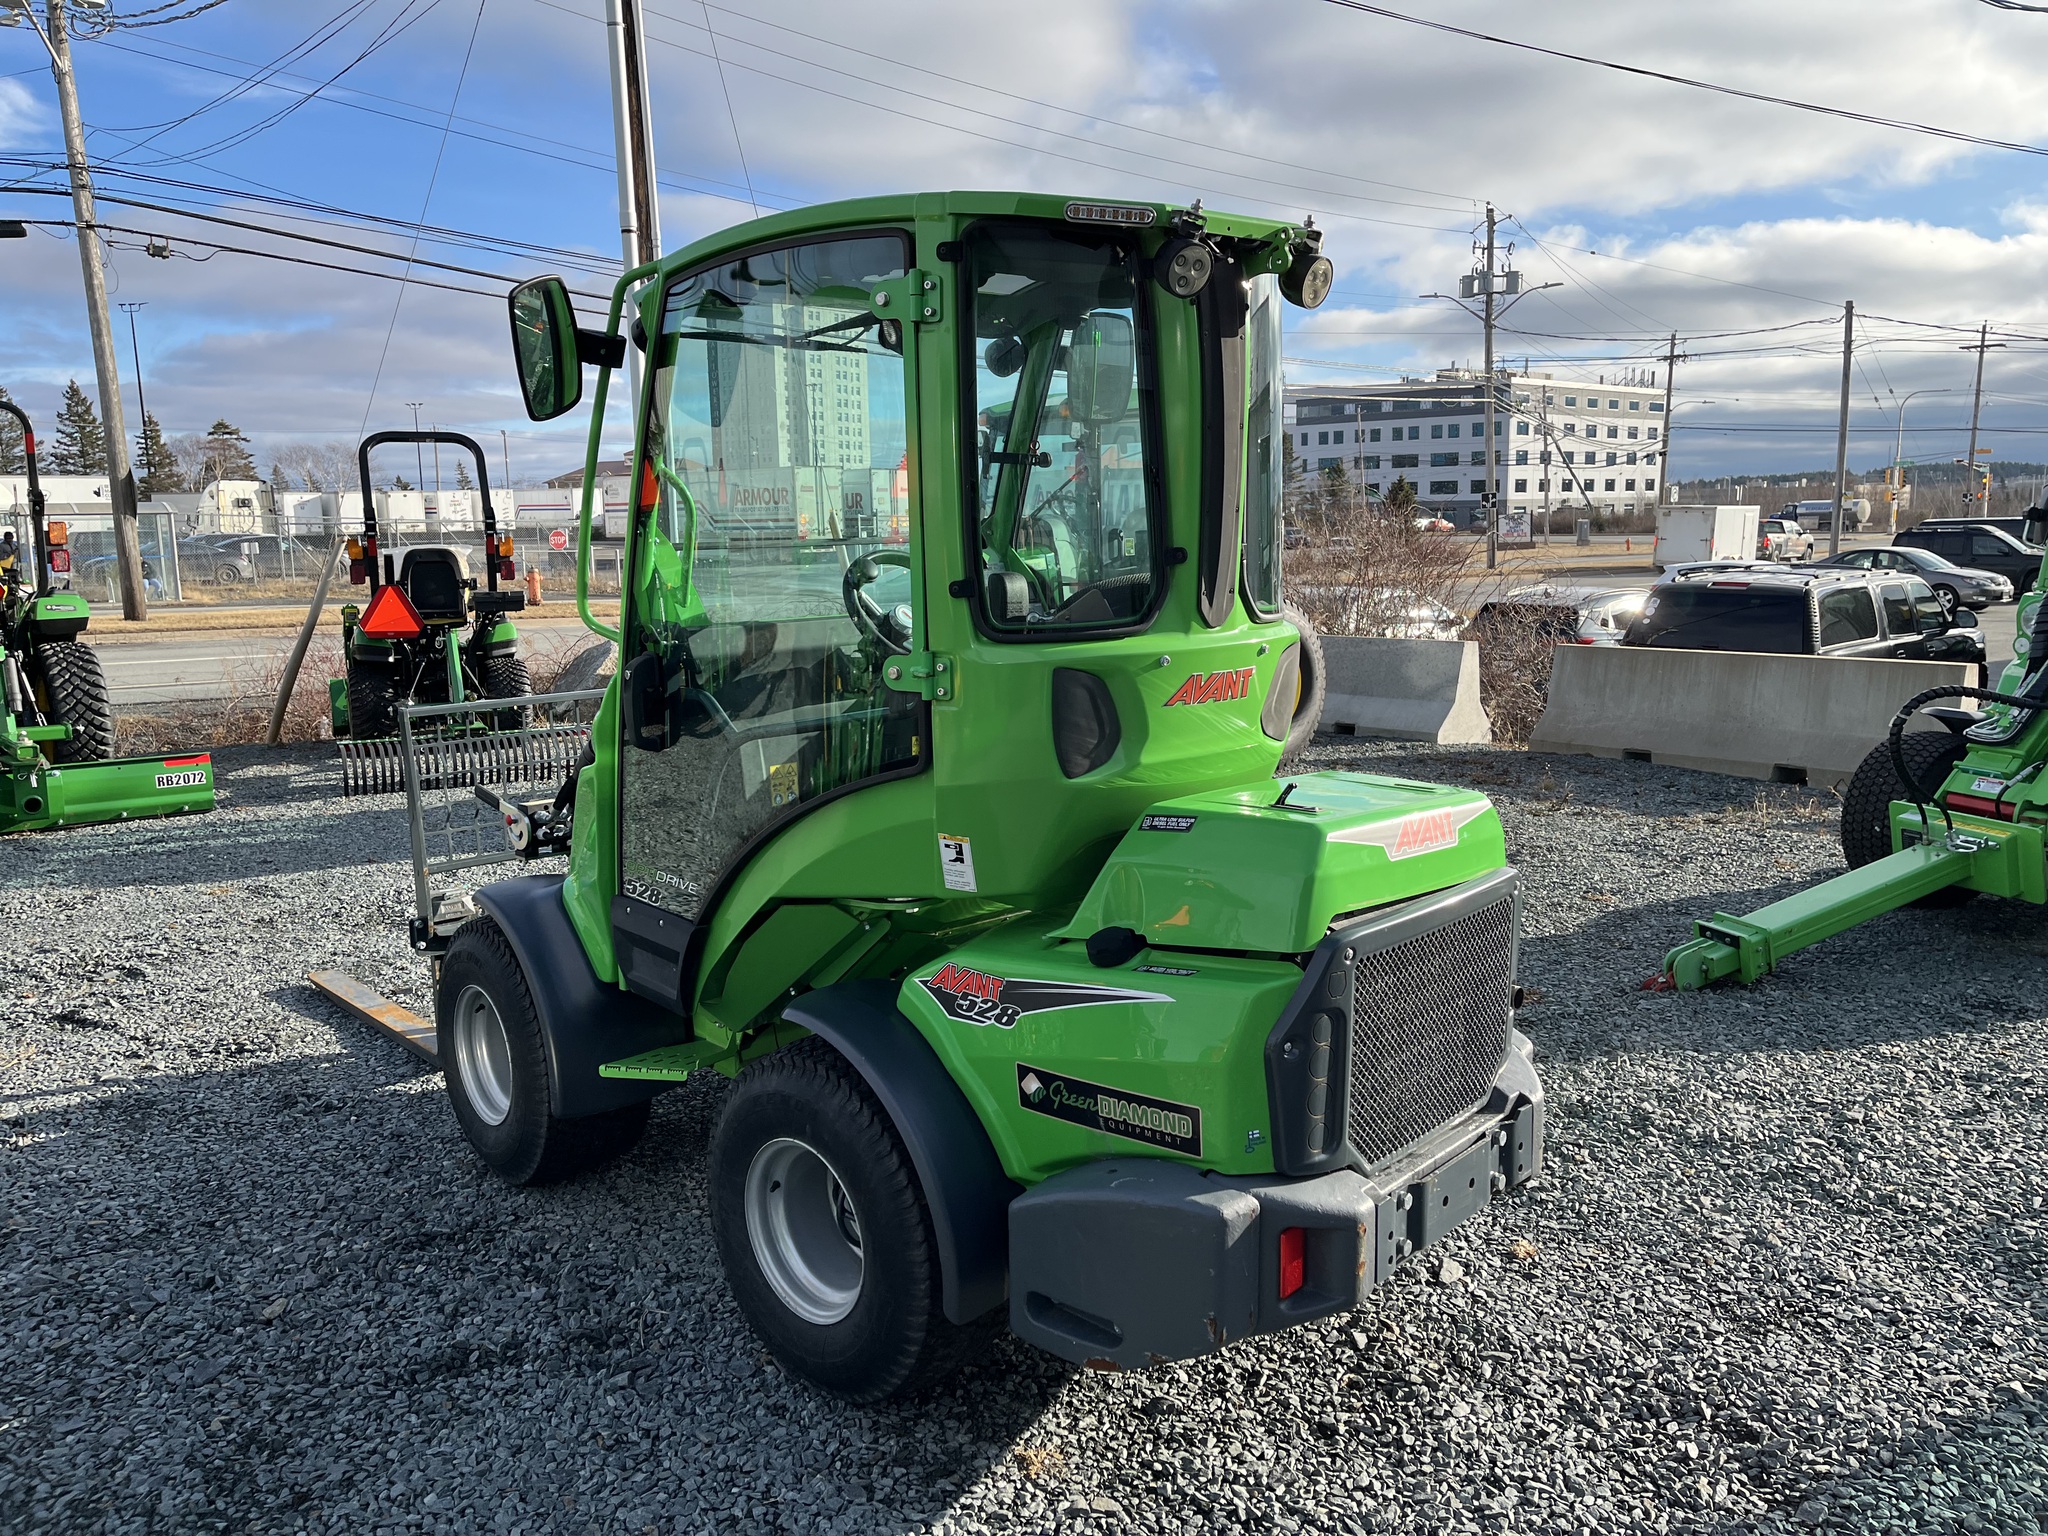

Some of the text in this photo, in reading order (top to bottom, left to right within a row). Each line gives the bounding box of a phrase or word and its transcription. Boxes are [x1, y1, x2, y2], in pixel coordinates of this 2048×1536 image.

[734, 487, 790, 506] ARMOUR
[550, 536, 566, 544] STOP
[1163, 666, 1256, 707] AVANT
[156, 772, 205, 787] RB2072
[1393, 810, 1454, 855] AVANT
[626, 877, 662, 906] 528
[927, 962, 1005, 1002] AVANT
[955, 991, 1022, 1029] 528
[1050, 1081, 1193, 1139] Green DIAMOND
[1100, 1118, 1182, 1145] EQUIPMENT
